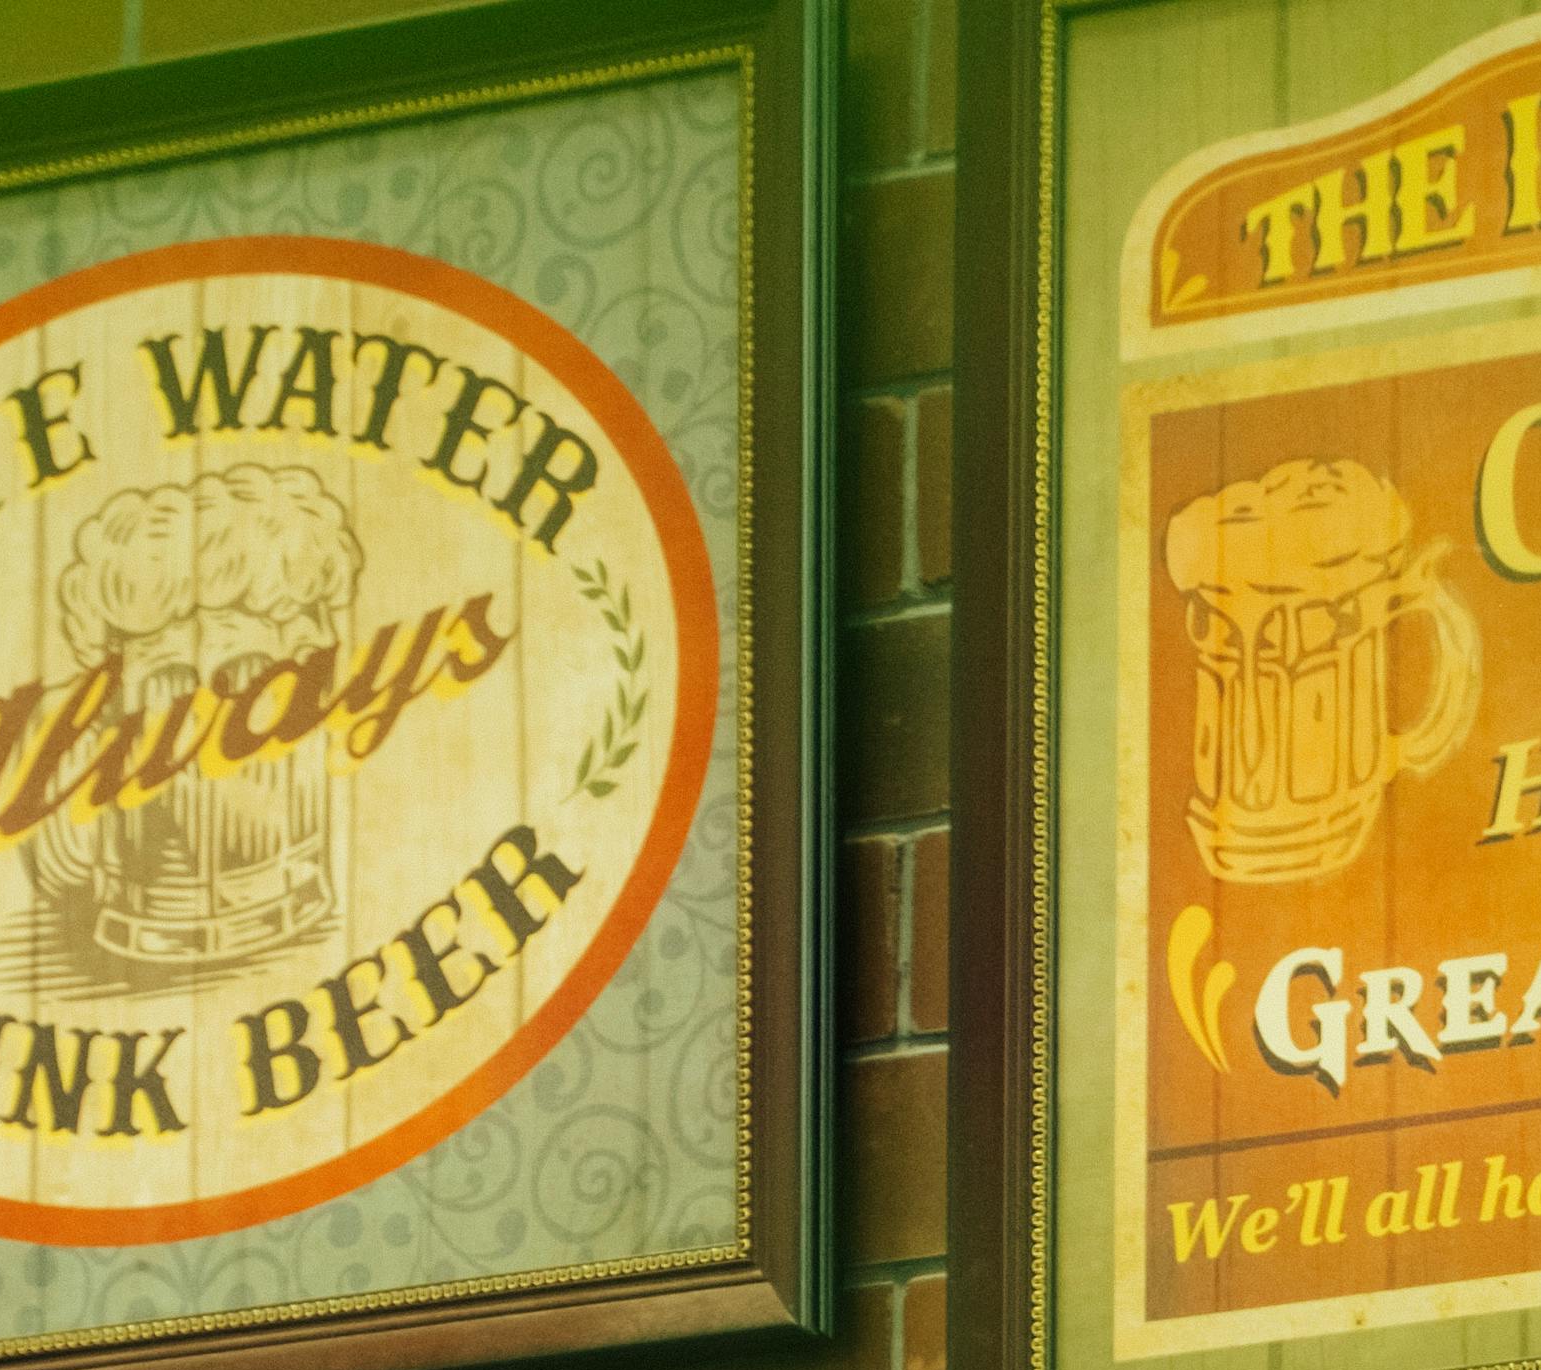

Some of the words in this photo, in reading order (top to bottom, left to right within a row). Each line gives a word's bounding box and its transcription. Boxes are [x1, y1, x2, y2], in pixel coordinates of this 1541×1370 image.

[1246, 124, 1476, 287] THE
[140, 325, 602, 554] WATER
[236, 824, 585, 1116] BEER
[1366, 1168, 1460, 1236] all
